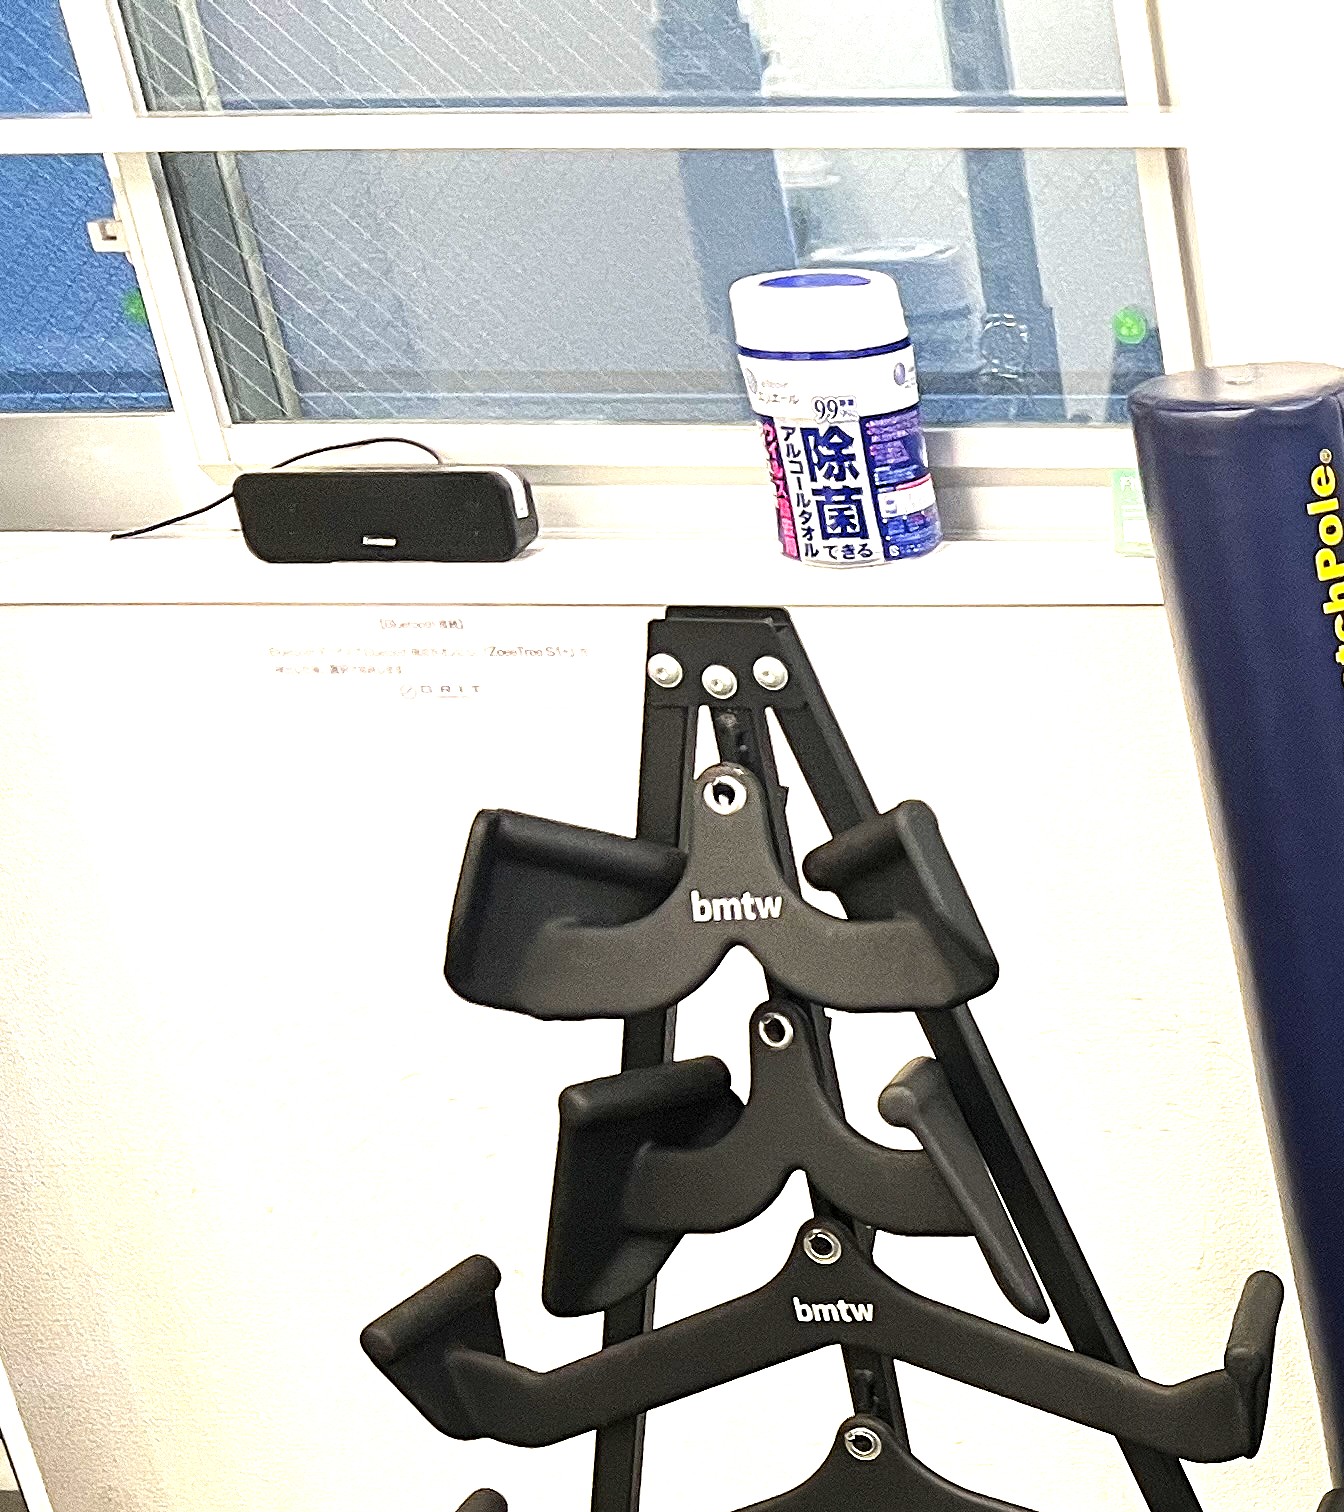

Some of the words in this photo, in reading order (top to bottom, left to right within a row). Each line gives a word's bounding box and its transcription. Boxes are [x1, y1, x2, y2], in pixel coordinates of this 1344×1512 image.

[780, 426, 820, 558] アルコールタオル
[799, 425, 870, 540] 除菌
[822, 543, 874, 560] できる
[691, 890, 782, 924] bmtw
[792, 1295, 874, 1325] bmtw
